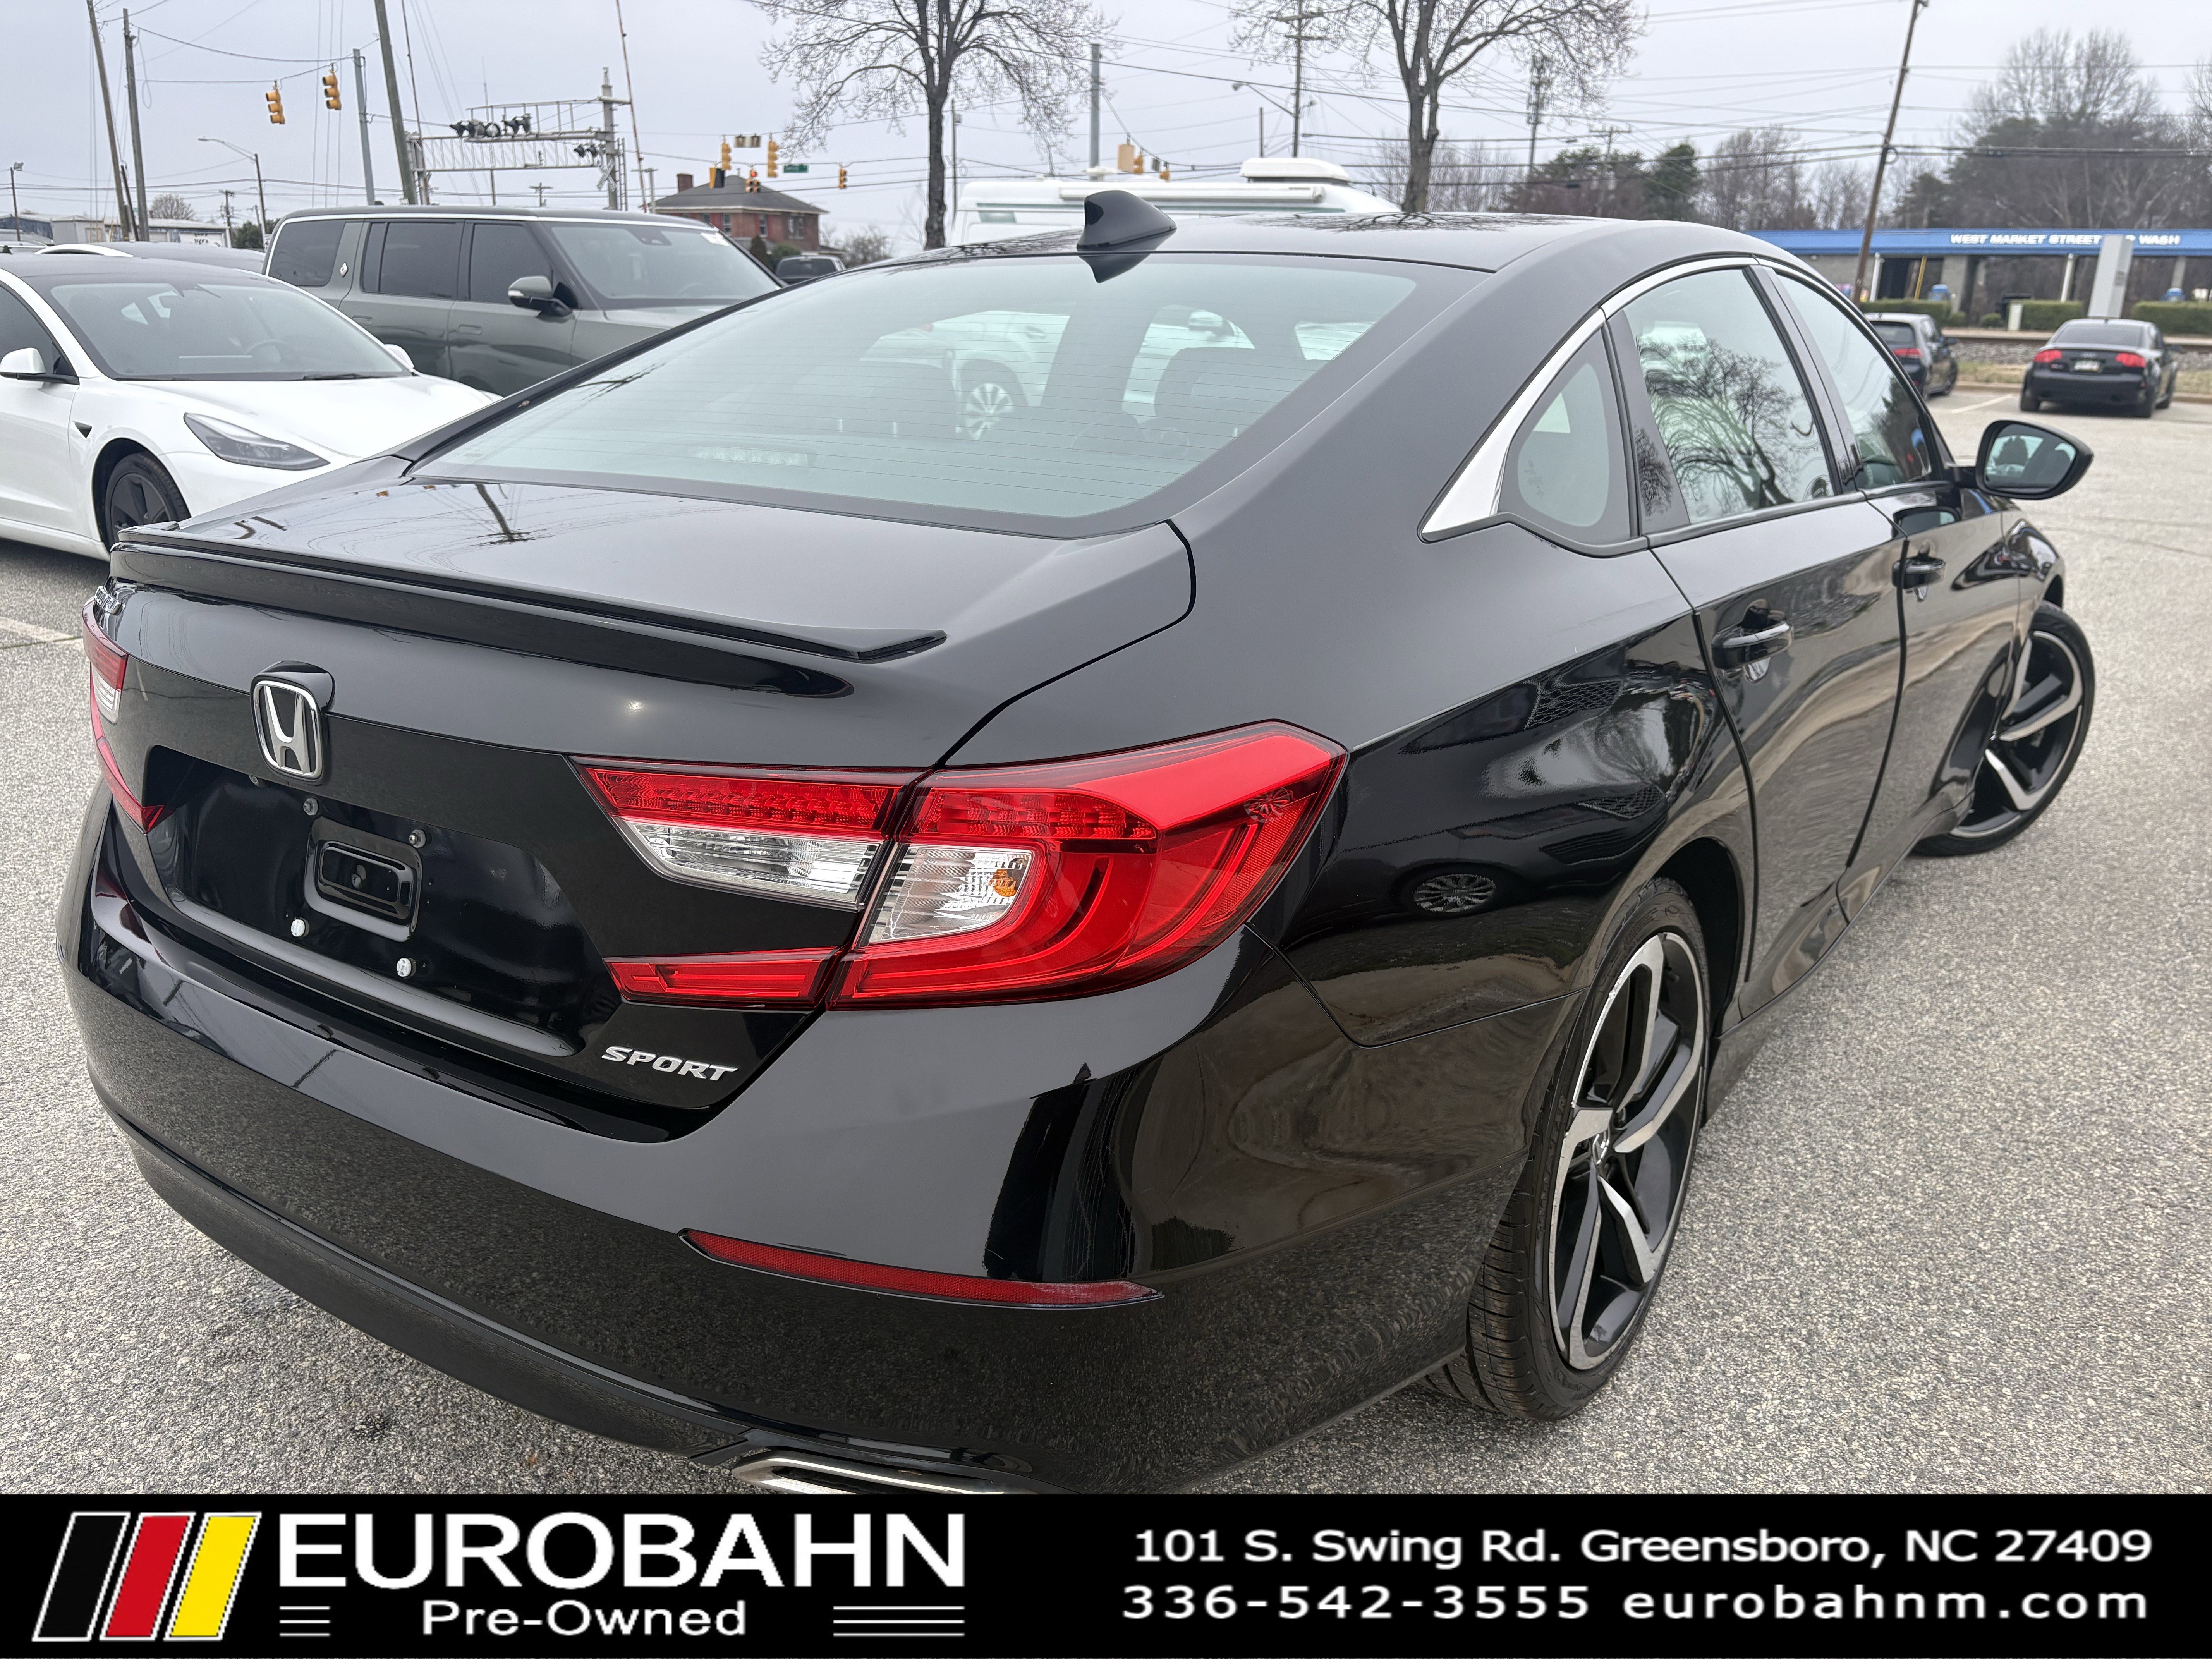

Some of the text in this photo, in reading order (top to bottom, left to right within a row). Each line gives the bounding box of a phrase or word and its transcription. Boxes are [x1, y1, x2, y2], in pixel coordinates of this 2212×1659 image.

[1951, 234, 1989, 244] WEST
[1990, 234, 2046, 244] MARKET
[2049, 235, 2102, 245] STREET
[2139, 235, 2181, 245] WASH
[601, 1046, 738, 1081] SPORT
